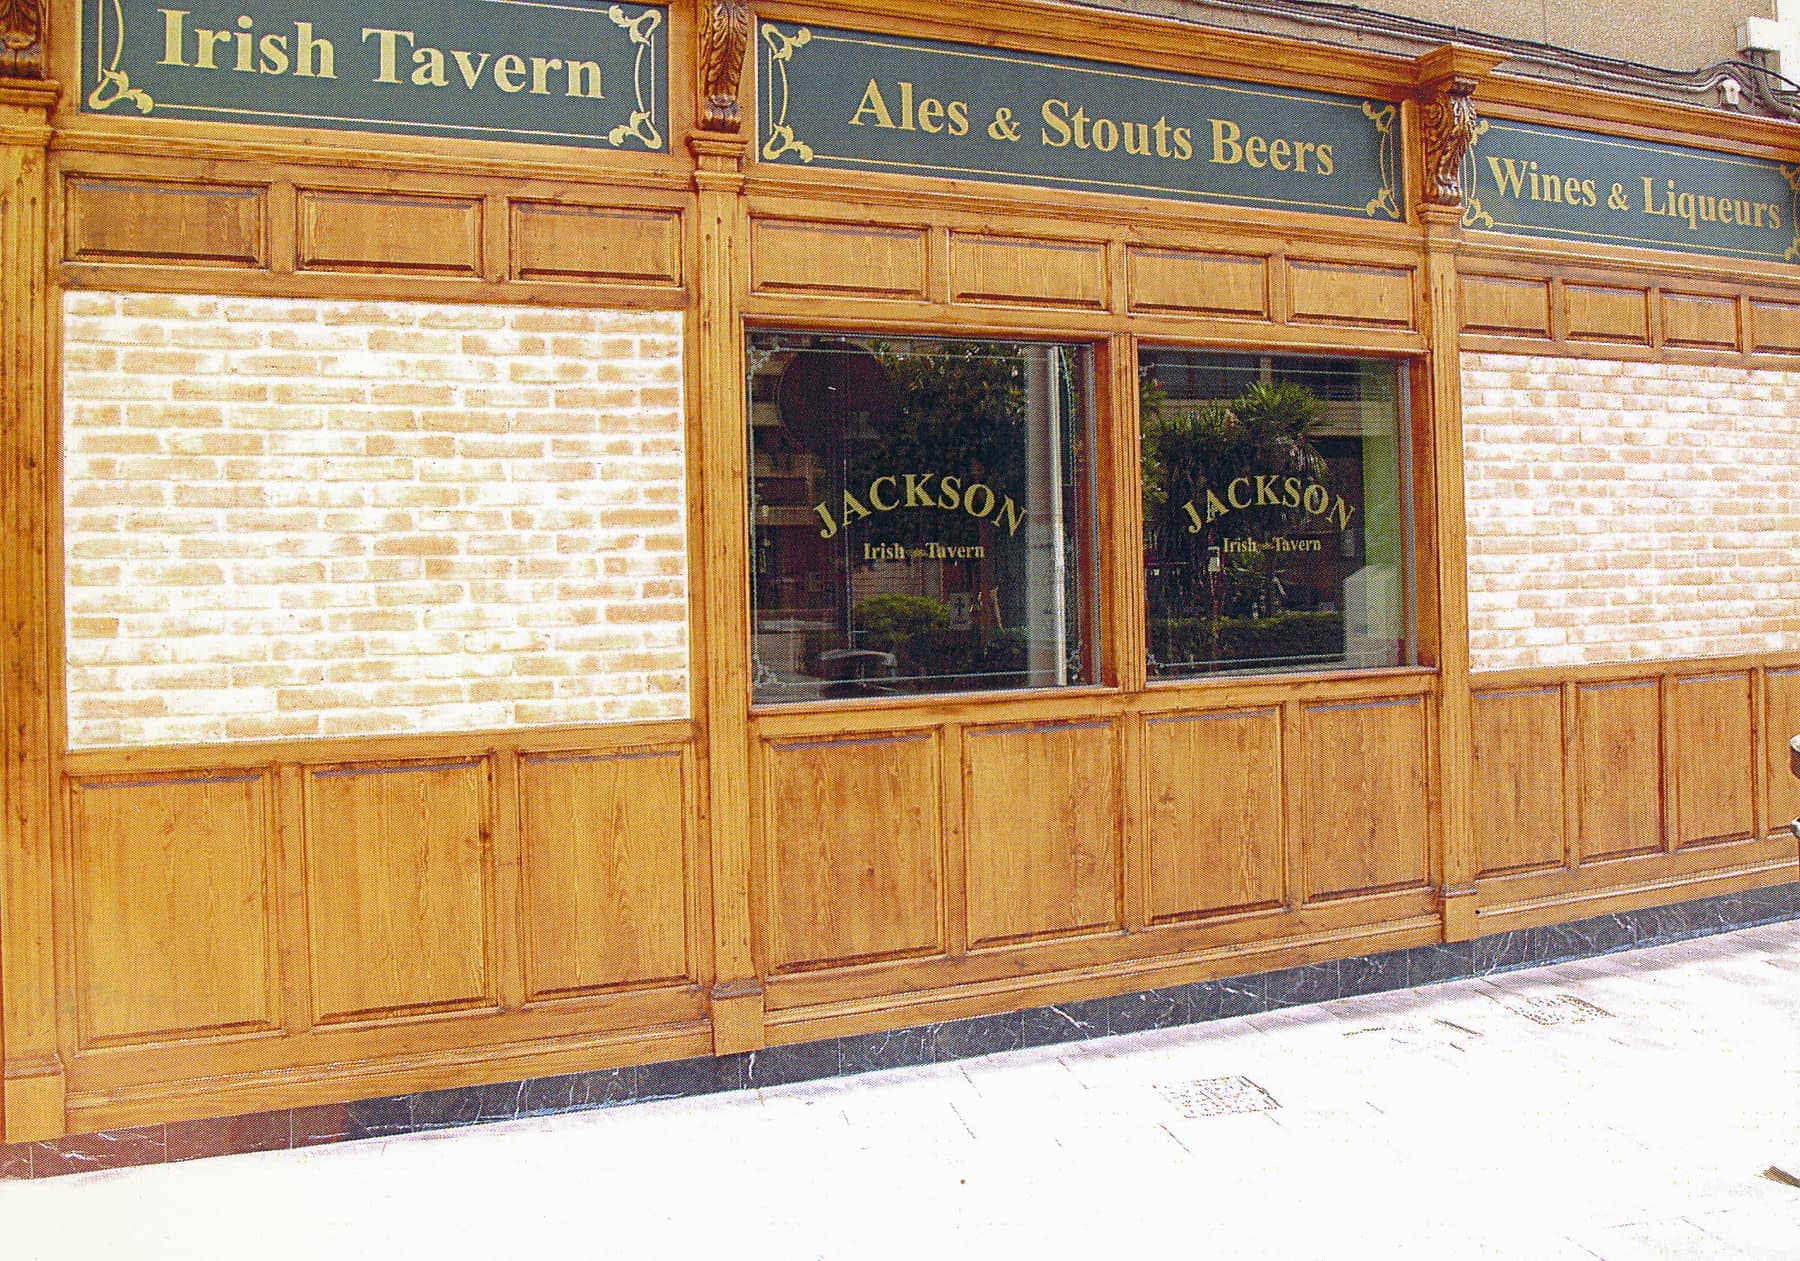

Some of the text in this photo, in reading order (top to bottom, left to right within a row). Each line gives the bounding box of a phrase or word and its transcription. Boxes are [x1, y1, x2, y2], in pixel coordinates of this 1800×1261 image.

[157, 8, 606, 99] Irish Tavern
[848, 77, 1335, 176] Ales & Stouts Beers
[1486, 155, 1783, 231] Wines & Liqueurs
[812, 472, 1029, 540] JACKSON
[1181, 474, 1357, 535] JACKSON
[863, 542, 986, 561] Irish Tavern
[1223, 536, 1322, 554] Irish Tavern
